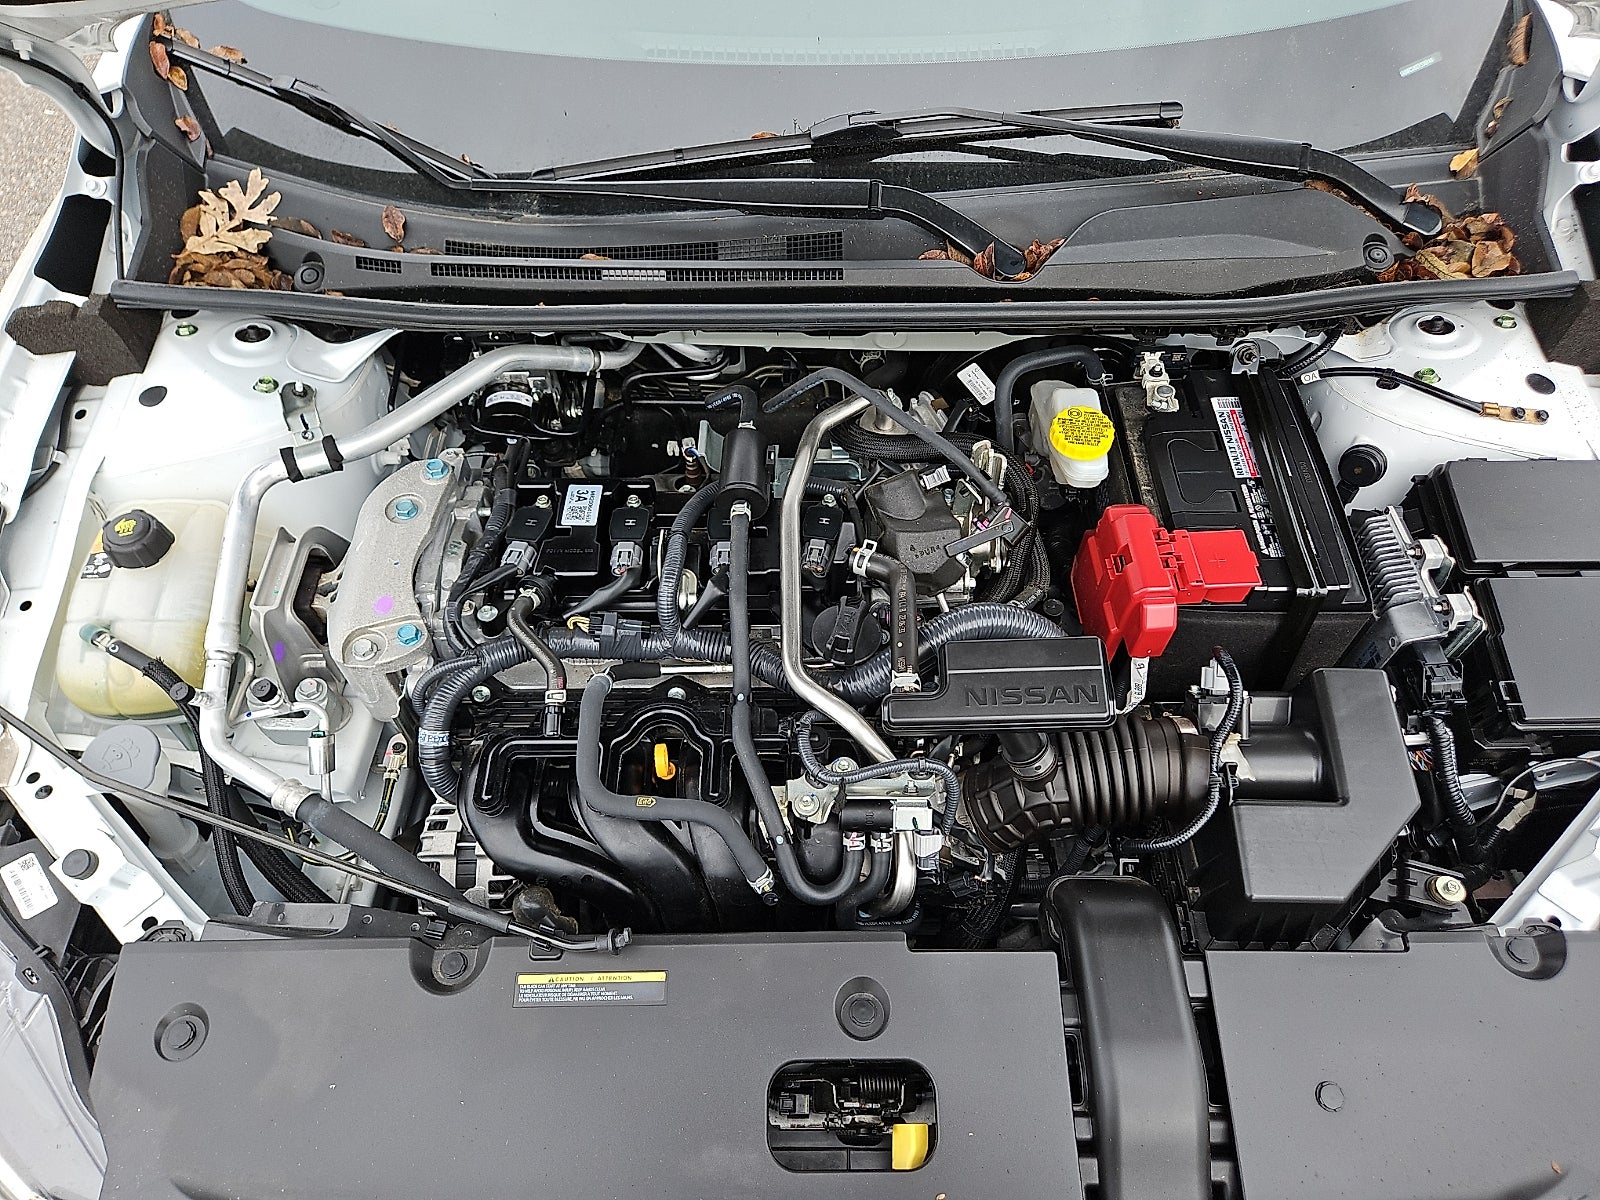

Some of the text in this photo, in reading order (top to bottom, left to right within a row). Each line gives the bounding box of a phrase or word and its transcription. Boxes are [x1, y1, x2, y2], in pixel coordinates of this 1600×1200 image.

[1217, 411, 1235, 444] NISSAN
[574, 489, 589, 503] 3A
[964, 683, 1100, 708] NISSAN
